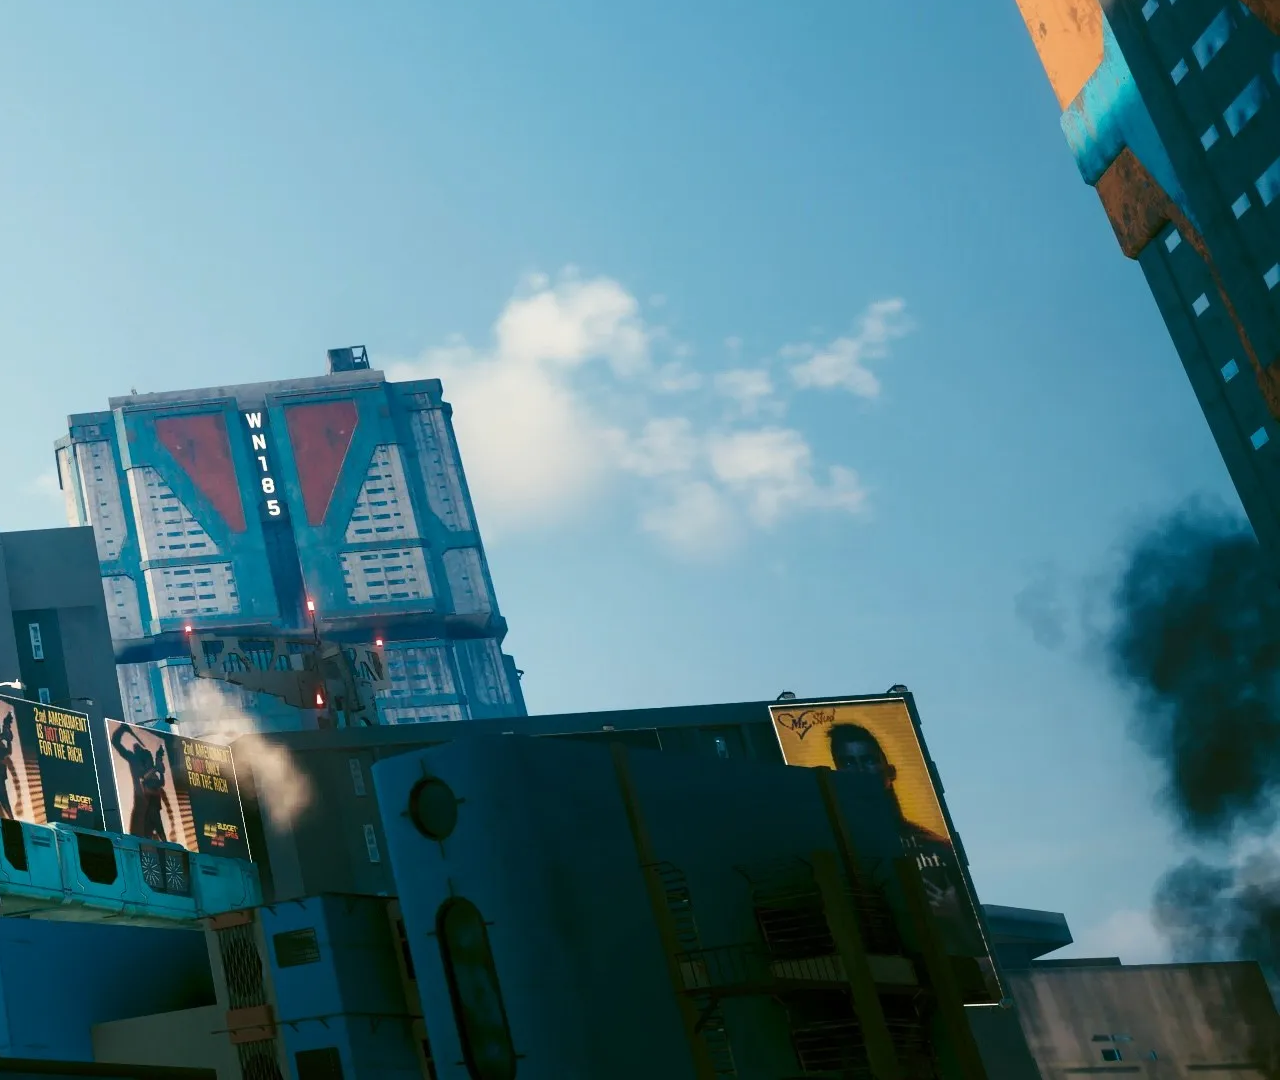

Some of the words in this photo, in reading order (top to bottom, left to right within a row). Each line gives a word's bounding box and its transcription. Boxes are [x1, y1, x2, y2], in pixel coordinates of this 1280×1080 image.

[34, 707, 47, 724] 2nd
[48, 710, 87, 732] AMENDMENT
[36, 723, 44, 739] IS
[44, 726, 58, 742] NOT
[58, 728, 75, 745] ONLY
[39, 739, 53, 756] FOR
[52, 742, 67, 760] THE
[67, 744, 84, 763] RICH
[205, 760, 221, 776] ONLY
[188, 771, 201, 787] FOR
[200, 773, 214, 791] THE
[214, 776, 229, 793] RICH
[68, 793, 93, 804] BUDGET
